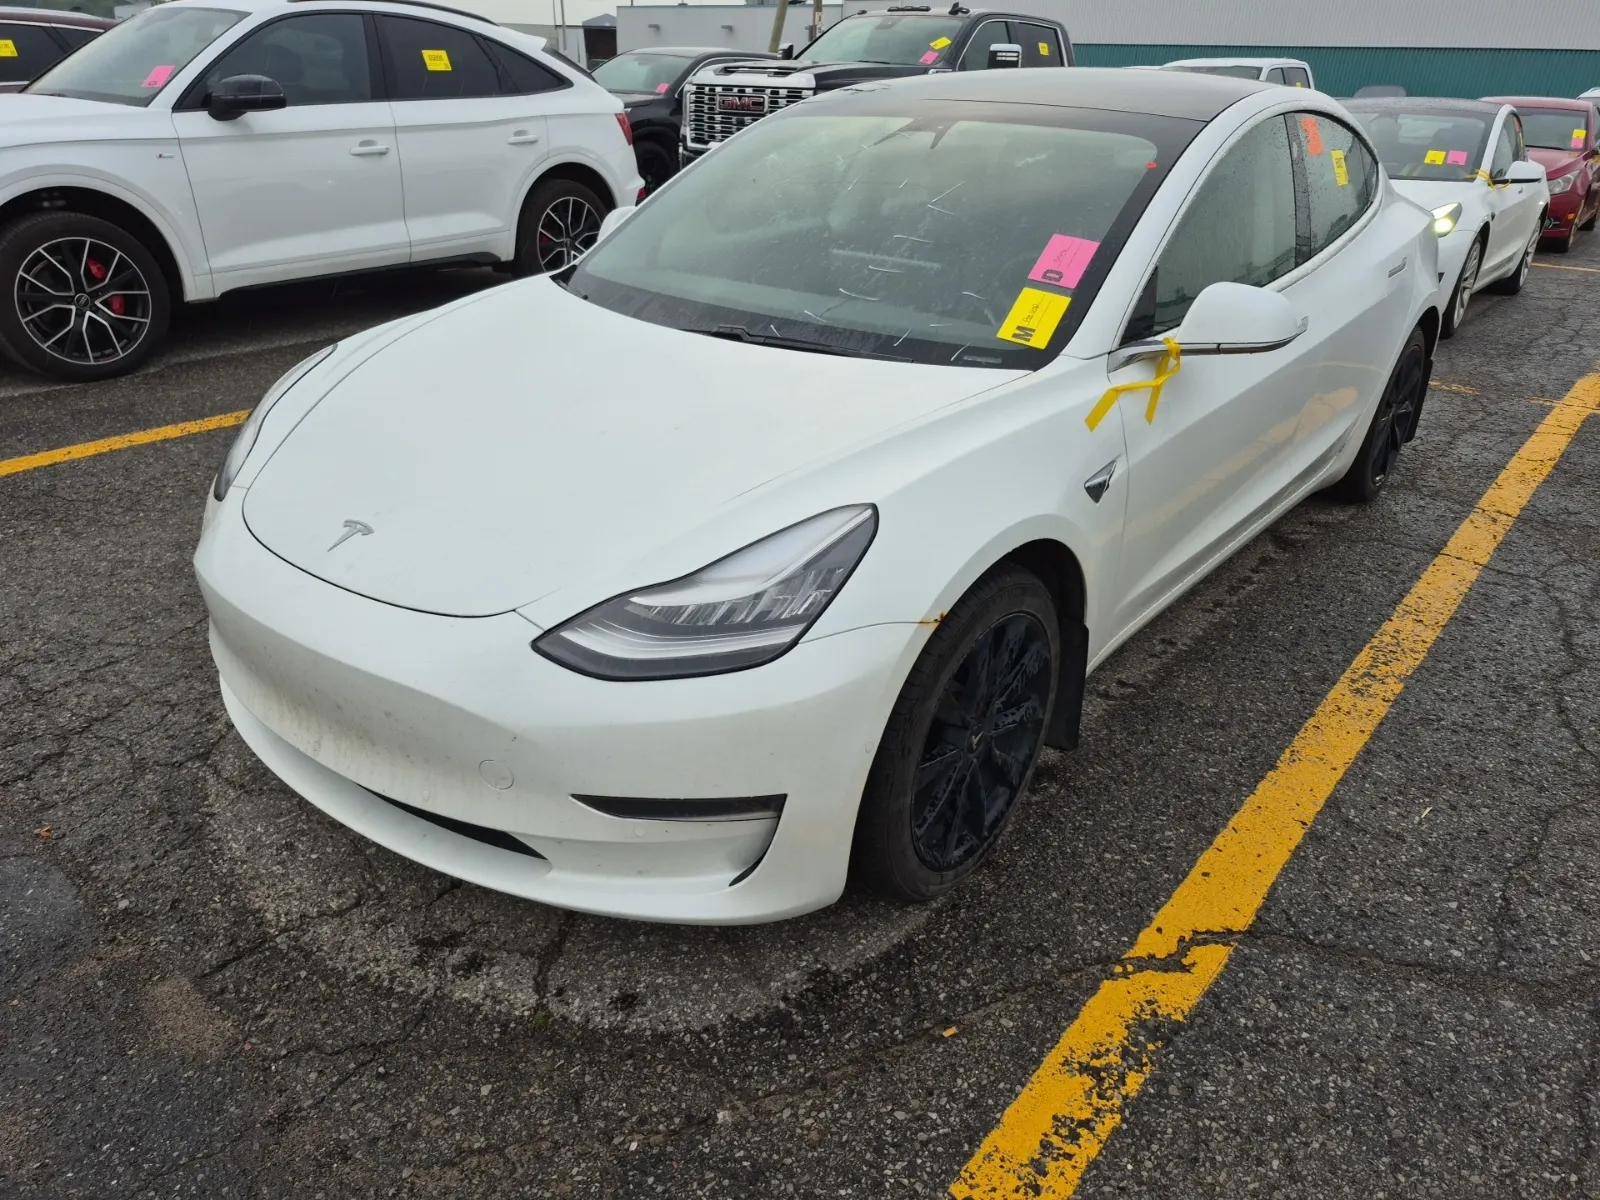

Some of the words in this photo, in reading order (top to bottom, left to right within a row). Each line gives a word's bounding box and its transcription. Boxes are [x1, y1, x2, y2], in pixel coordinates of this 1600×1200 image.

[719, 97, 764, 110] GMC
[1041, 269, 1063, 282] D
[1011, 325, 1036, 342] M
